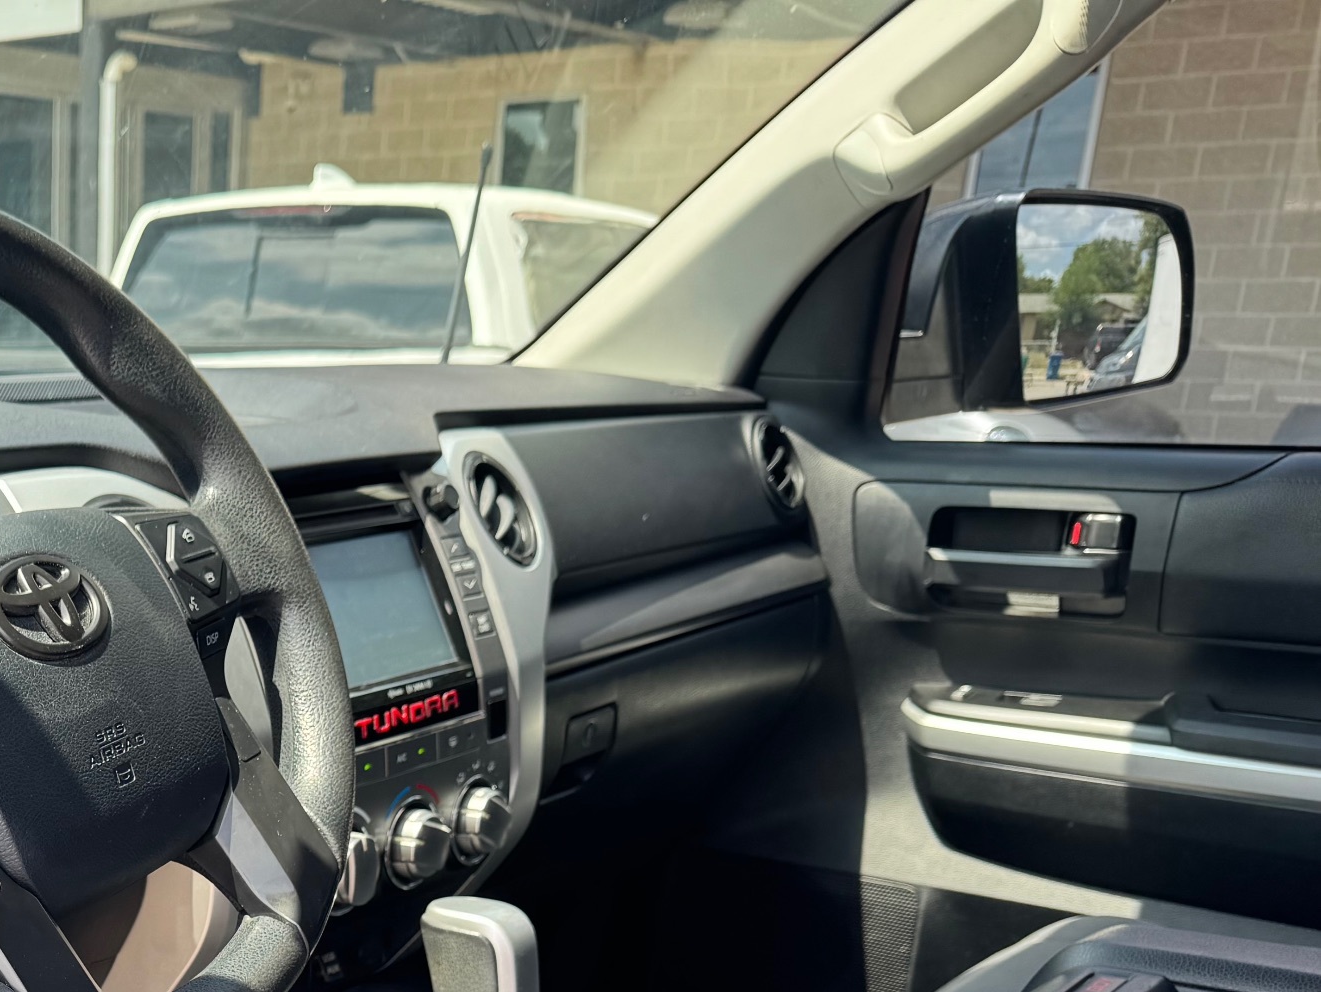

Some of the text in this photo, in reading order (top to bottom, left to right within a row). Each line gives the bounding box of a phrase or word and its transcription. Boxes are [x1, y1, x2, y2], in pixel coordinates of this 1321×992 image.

[206, 631, 219, 646] DISP
[354, 688, 460, 740] TUNDRA
[96, 721, 127, 745] SRS
[90, 732, 146, 770] AIRBAG
